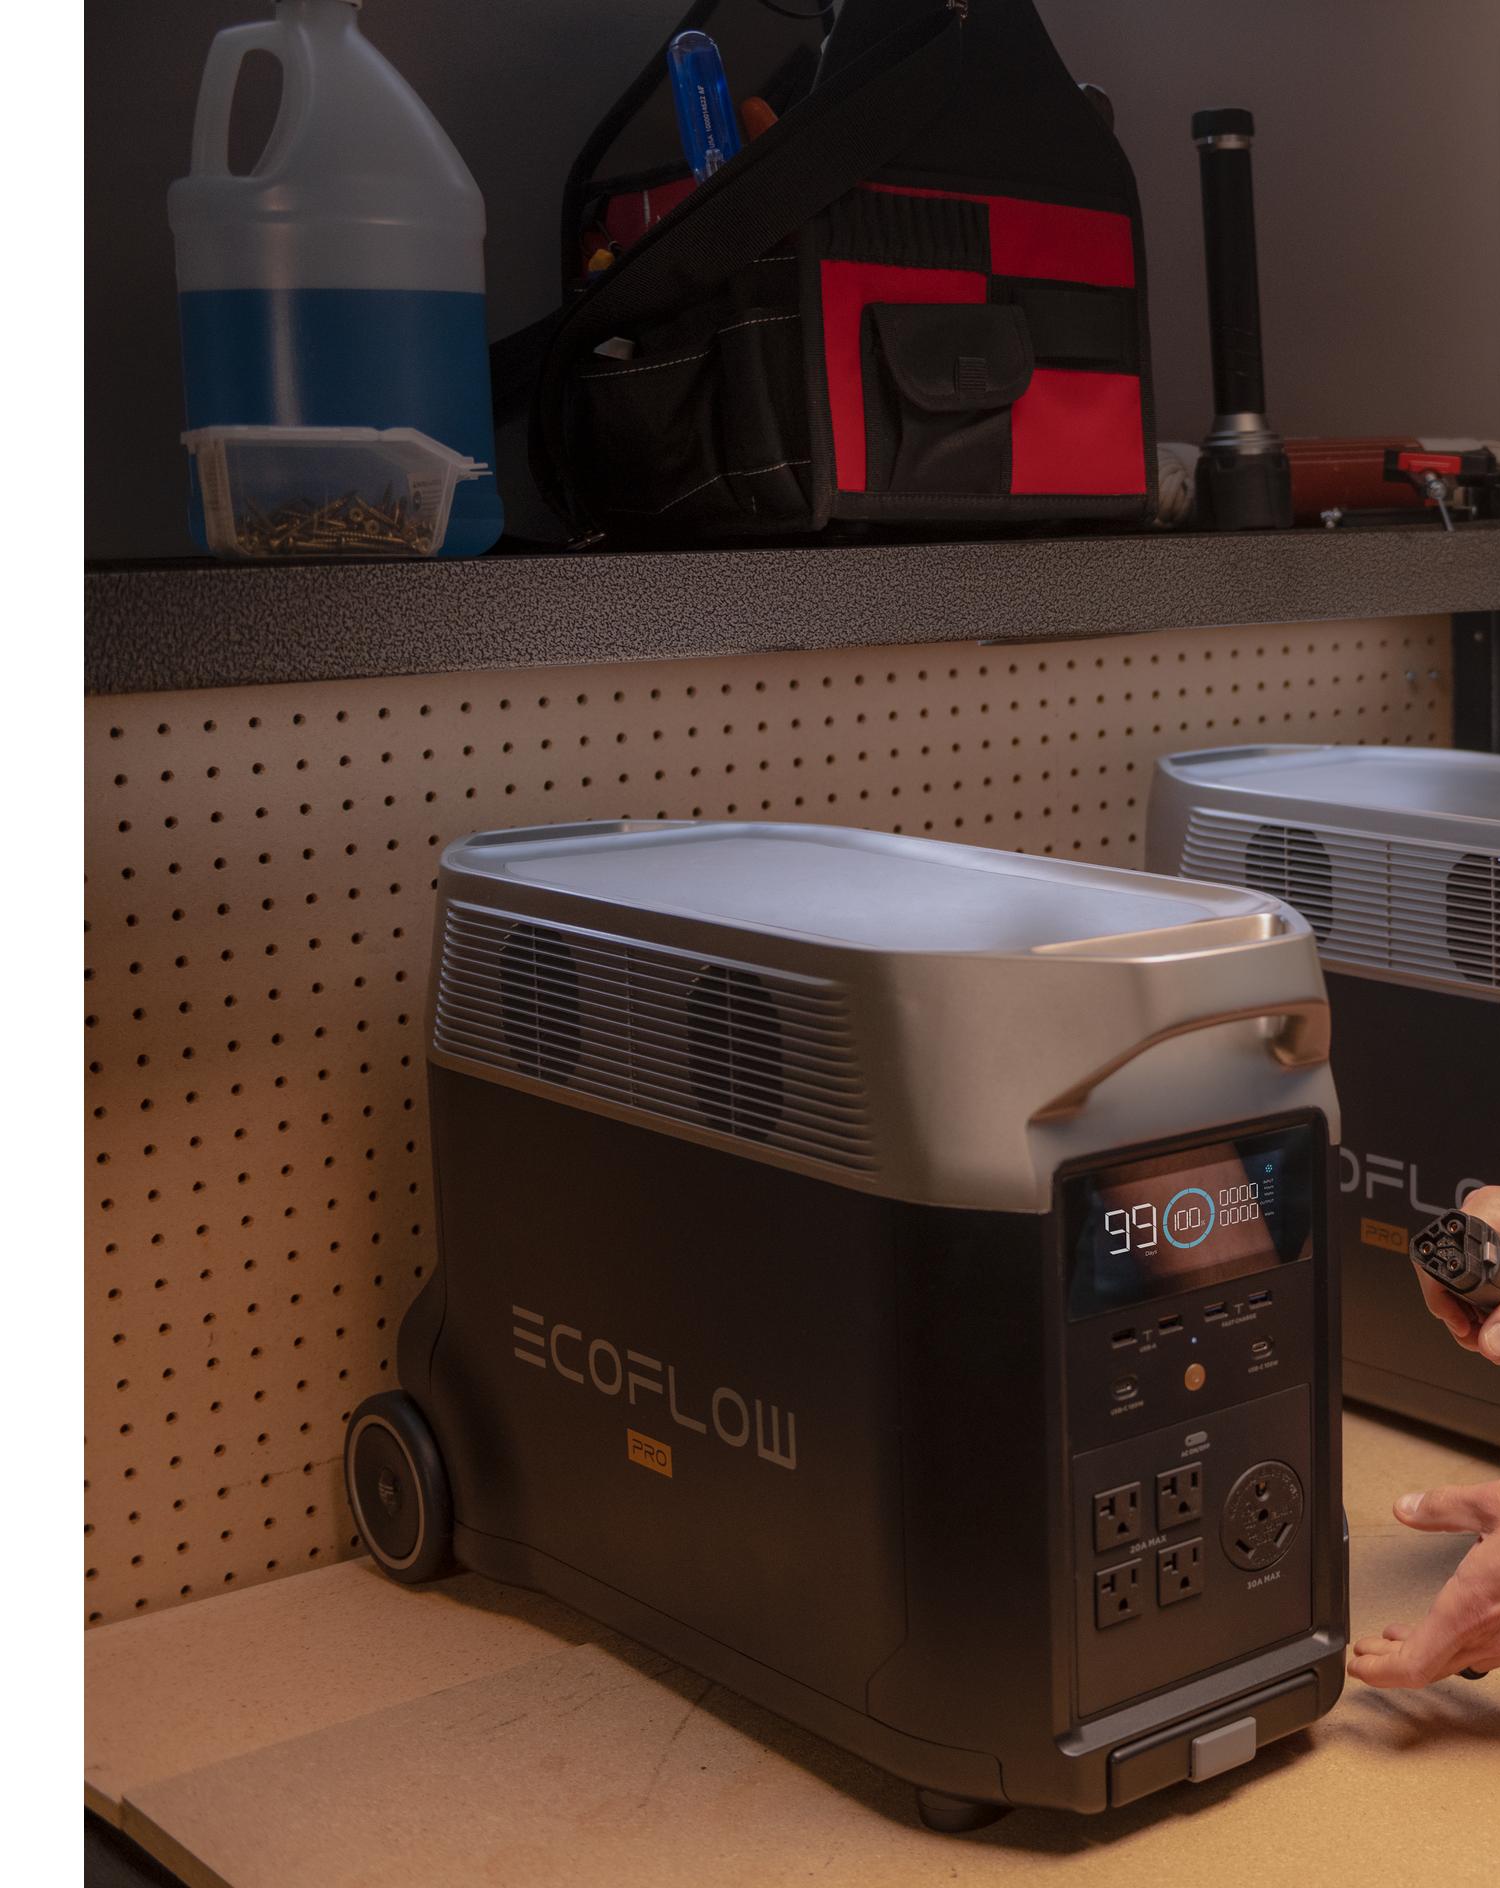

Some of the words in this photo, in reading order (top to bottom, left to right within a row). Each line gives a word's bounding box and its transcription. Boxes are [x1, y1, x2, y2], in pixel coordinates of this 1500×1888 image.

[1104, 1202, 1158, 1256] 99
[511, 1304, 797, 1470] ECOFLOW
[630, 1437, 668, 1468] PRO
[1148, 1534, 1168, 1547] MAX
[1263, 1570, 1281, 1584] MAX
